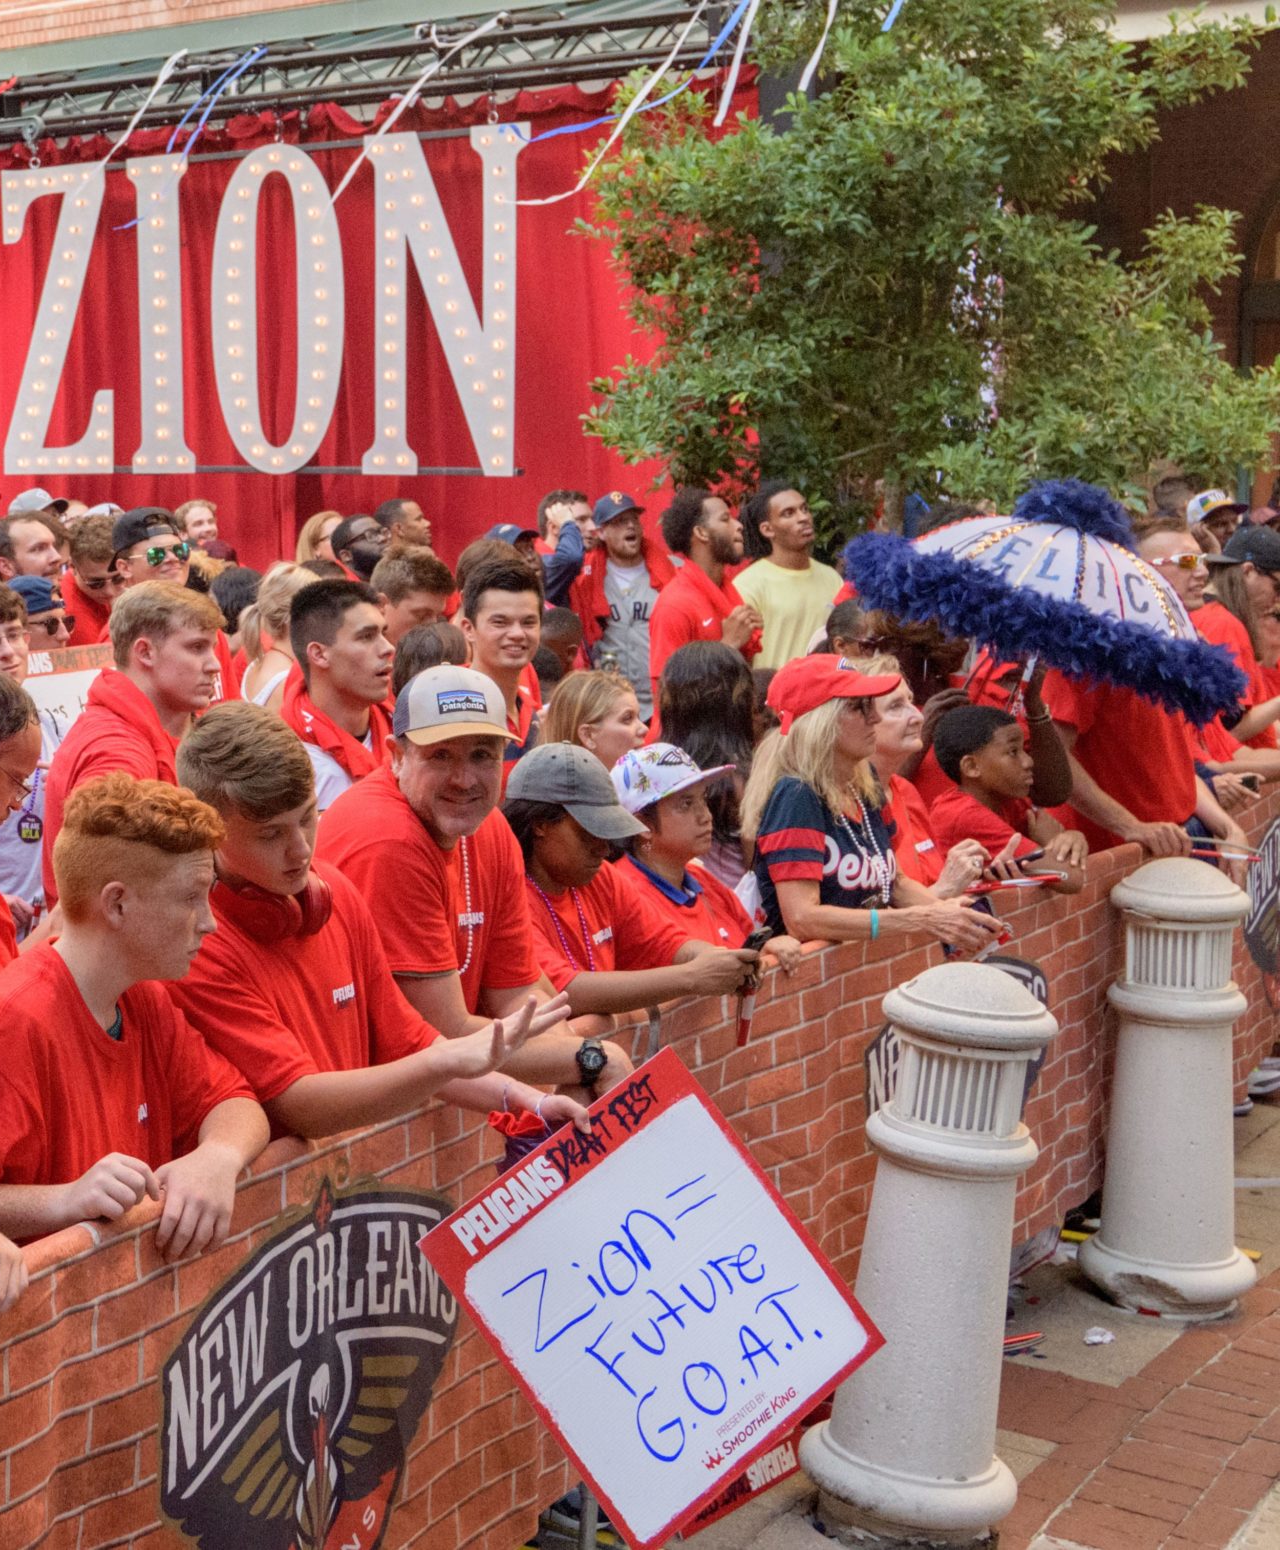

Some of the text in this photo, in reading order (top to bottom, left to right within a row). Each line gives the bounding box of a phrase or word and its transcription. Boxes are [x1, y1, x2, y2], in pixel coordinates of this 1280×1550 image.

[1, 122, 531, 477] ZION
[442, 701, 485, 712] patagonia
[450, 1073, 658, 1257] PELICANS DRAFT FEST
[584, 1243, 765, 1398] Future
[167, 1270, 271, 1495] NEW
[716, 1400, 757, 1438] PRESENTED
[722, 1407, 773, 1456] SMOOTHIE
[746, 1439, 798, 1492] PELICANS
